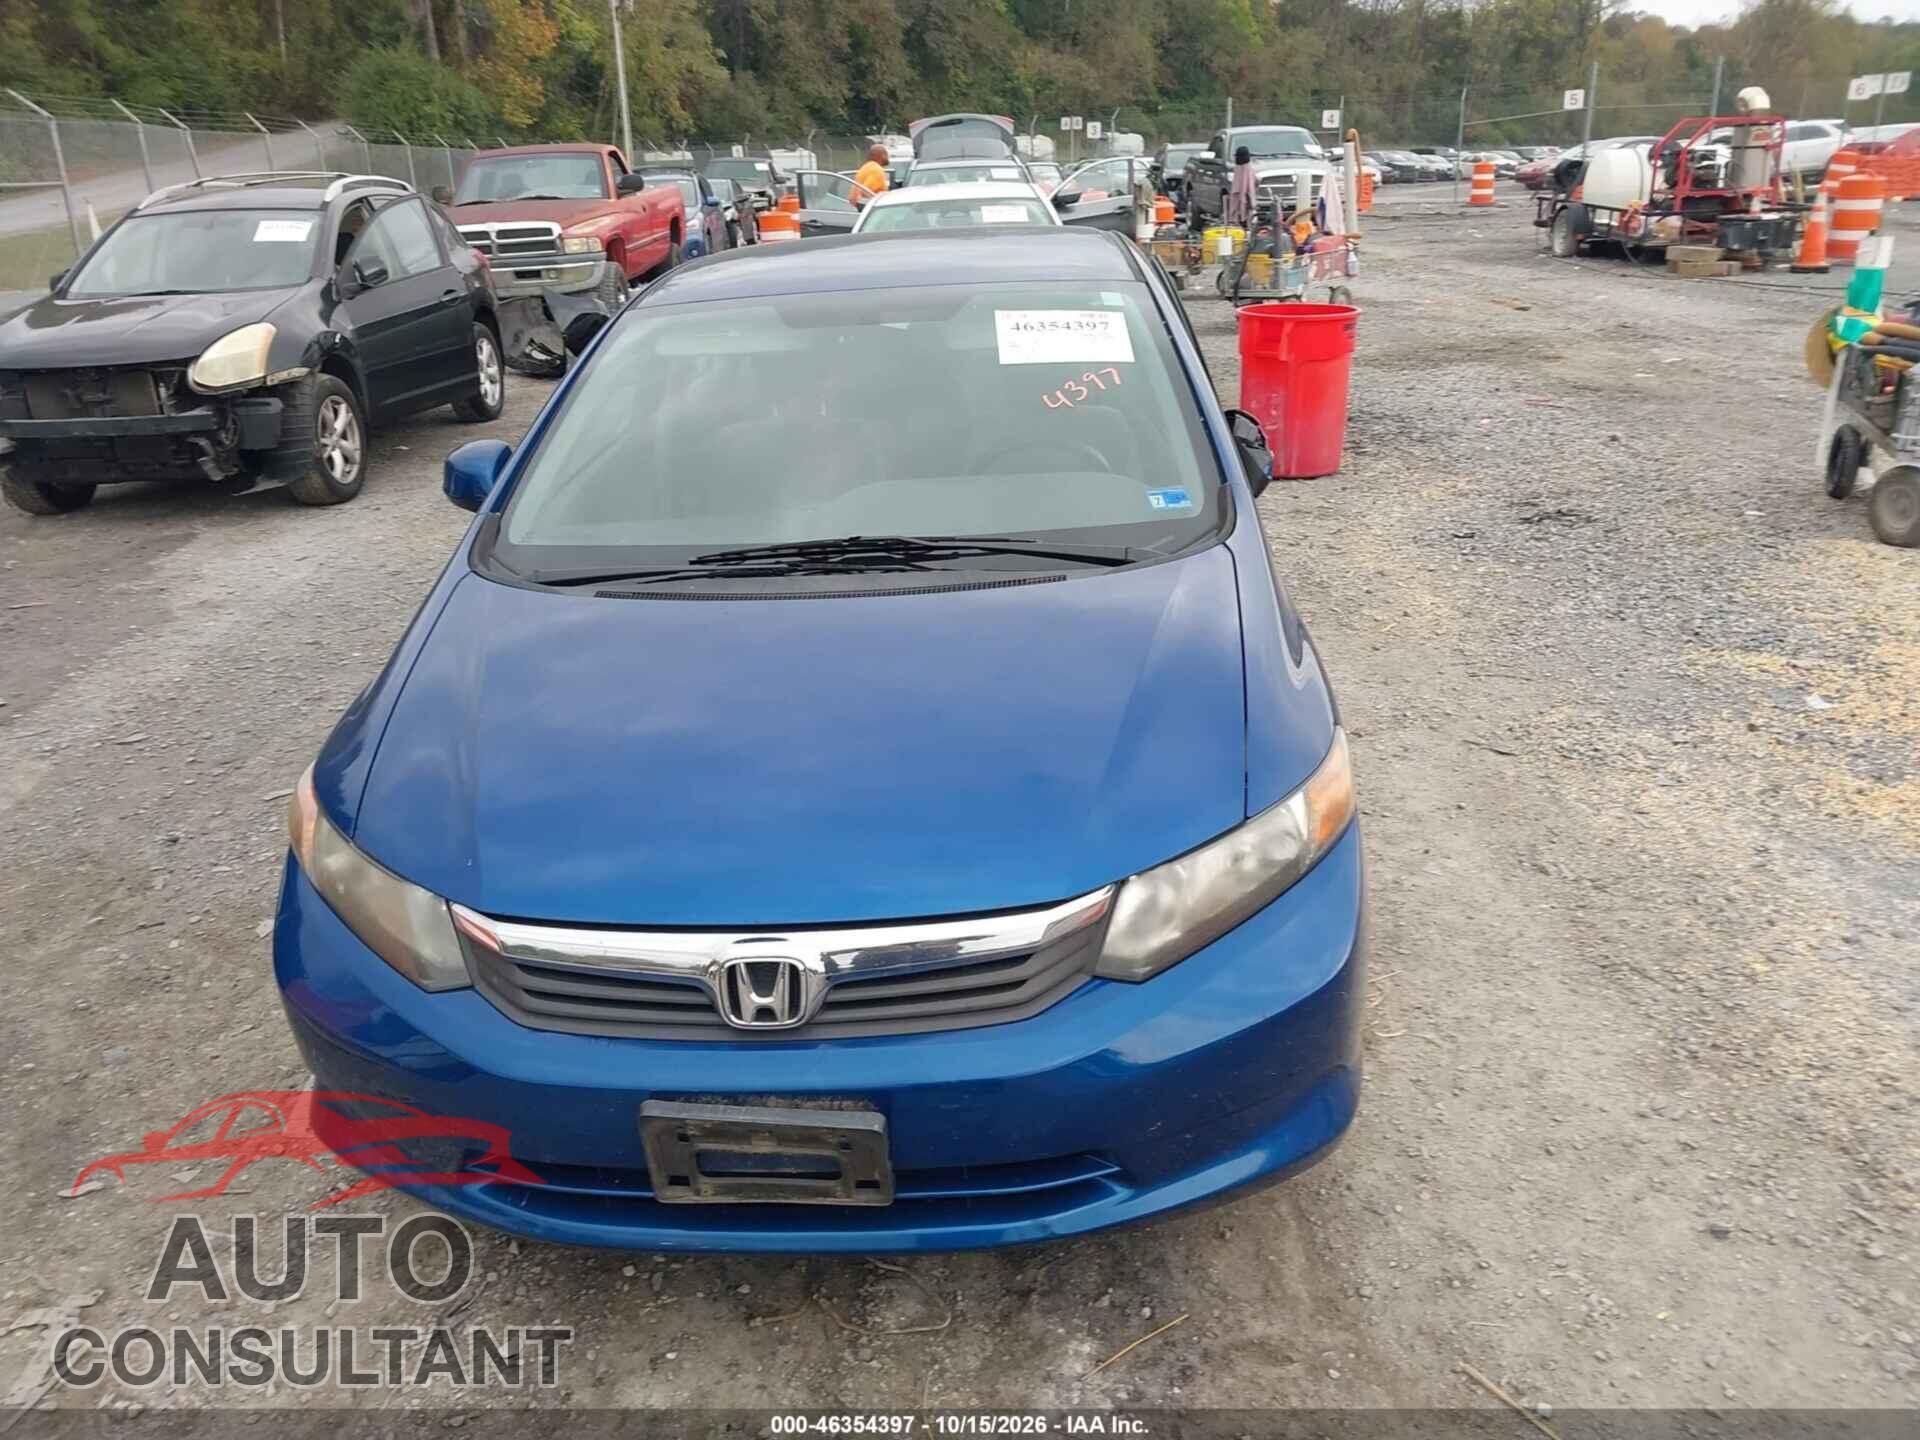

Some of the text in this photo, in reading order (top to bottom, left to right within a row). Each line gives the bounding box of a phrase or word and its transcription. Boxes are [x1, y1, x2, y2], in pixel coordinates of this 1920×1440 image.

[1568, 93, 1578, 106] 5
[1010, 320, 1109, 332] 46354397
[1042, 367, 1121, 409] 4397
